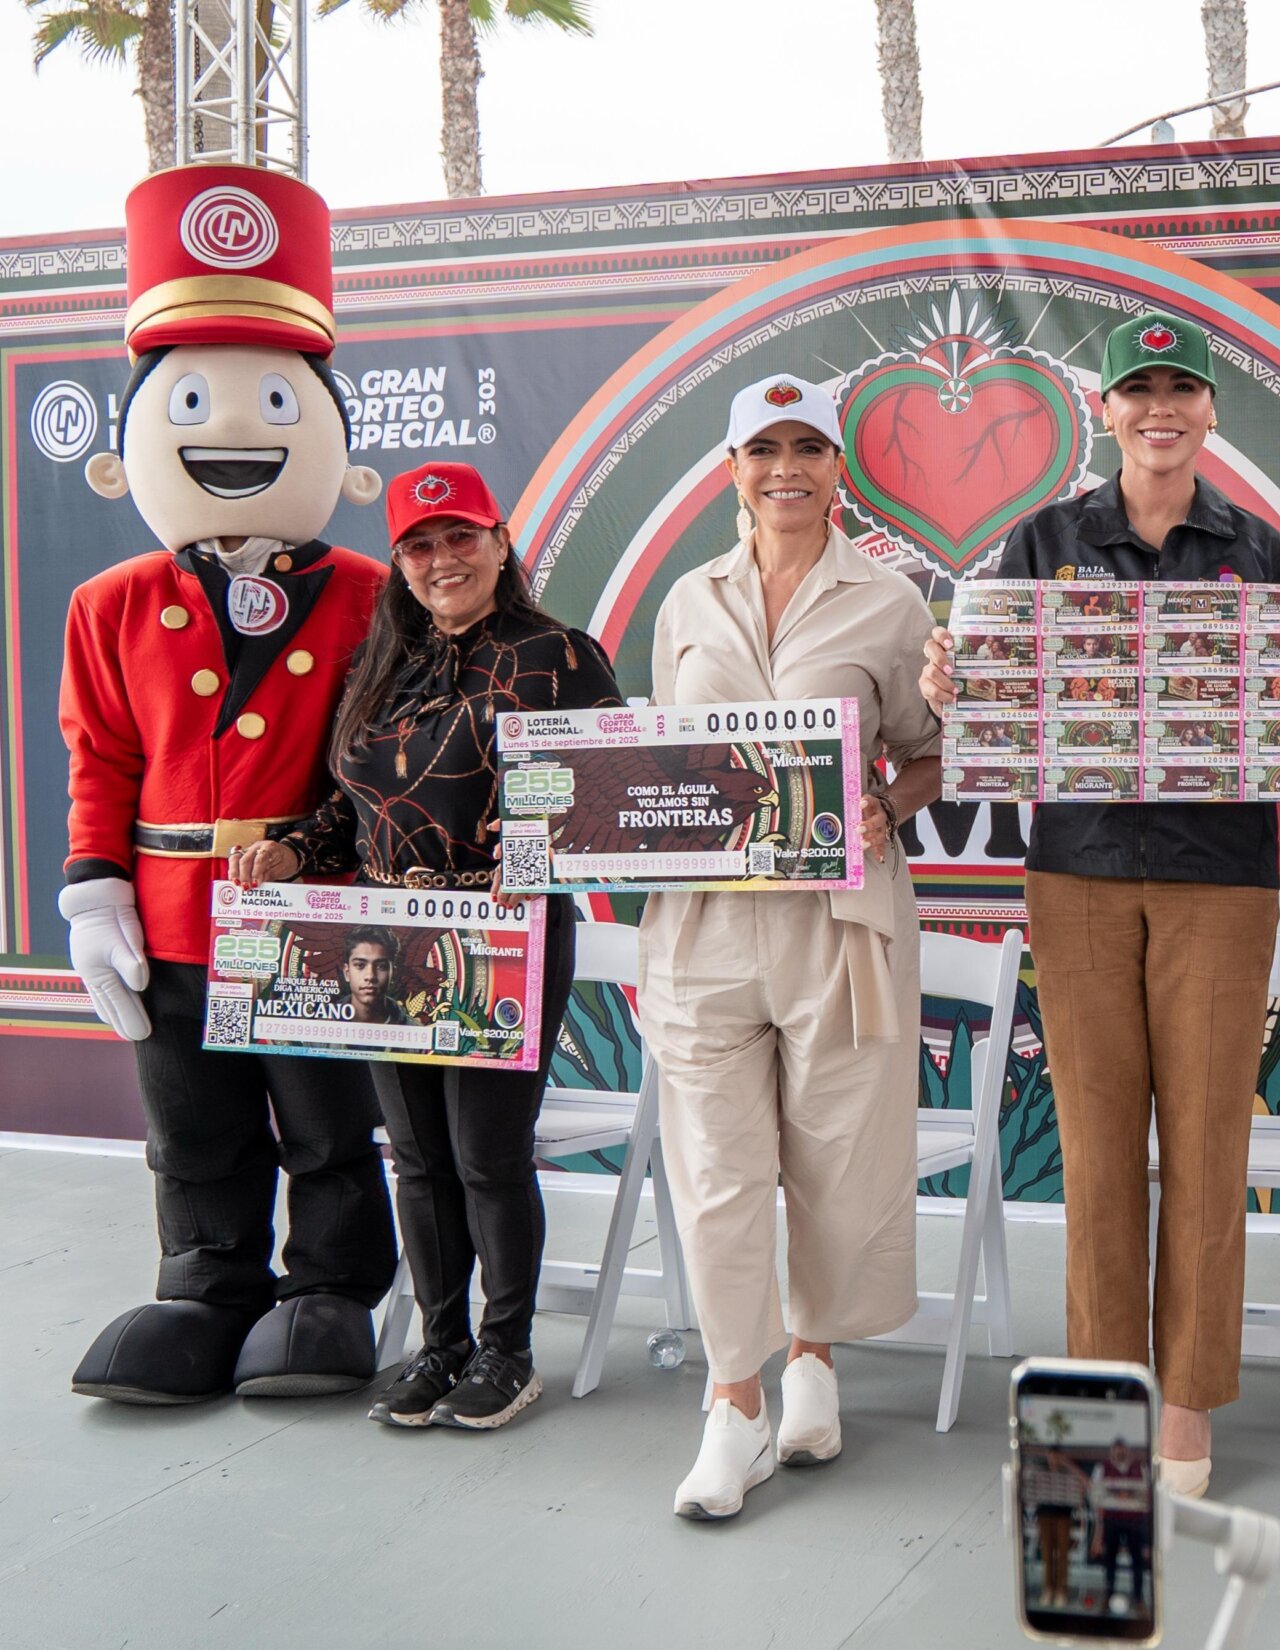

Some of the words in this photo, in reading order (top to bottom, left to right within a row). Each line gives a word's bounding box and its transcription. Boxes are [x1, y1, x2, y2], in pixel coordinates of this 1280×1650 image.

[360, 366, 447, 396] GRAN
[478, 367, 496, 416] 303
[345, 394, 445, 424] ORTEO
[527, 715, 570, 727] LOTERÍA
[603, 719, 634, 727] SORTEO
[527, 727, 580, 736] NACIONAL
[603, 726, 642, 734] ESPECIAL
[503, 741, 529, 749] Lunes
[542, 739, 552, 747] de
[554, 738, 601, 748] septiembre
[606, 737, 616, 745] de
[619, 736, 639, 744] 2025
[506, 770, 574, 794] 255
[627, 786, 658, 796] COMO
[662, 785, 675, 796] EL
[678, 783, 719, 796] ÁGUILA,
[507, 795, 573, 807] MILLONES
[637, 797, 690, 808] VOLAMOS
[691, 797, 709, 806] SIN
[619, 808, 733, 828] FRONTERAS
[775, 849, 800, 859] Valor
[801, 848, 845, 859] $200.00
[241, 888, 281, 898] LOTERÍA
[241, 898, 289, 907] NACIONAL
[311, 903, 347, 911] ESPECIAL
[217, 908, 241, 916] Lunes
[243, 908, 251, 916] 15
[253, 909, 262, 917] de
[265, 910, 311, 920] septiembre
[313, 912, 322, 920] de
[324, 913, 343, 921] 2025
[215, 936, 280, 961] 255
[215, 960, 277, 972] MILLONES
[276, 977, 306, 986] AUNQUE
[308, 978, 318, 987] EL
[320, 979, 339, 988] ACTA
[274, 984, 292, 993] DIGA
[294, 985, 340, 995] AMERICANO
[287, 993, 302, 1002] AM
[305, 993, 330, 1003] PURO
[256, 999, 355, 1020] MEXICANO
[460, 1028, 482, 1038] Valor
[483, 1029, 524, 1040] $200.00
